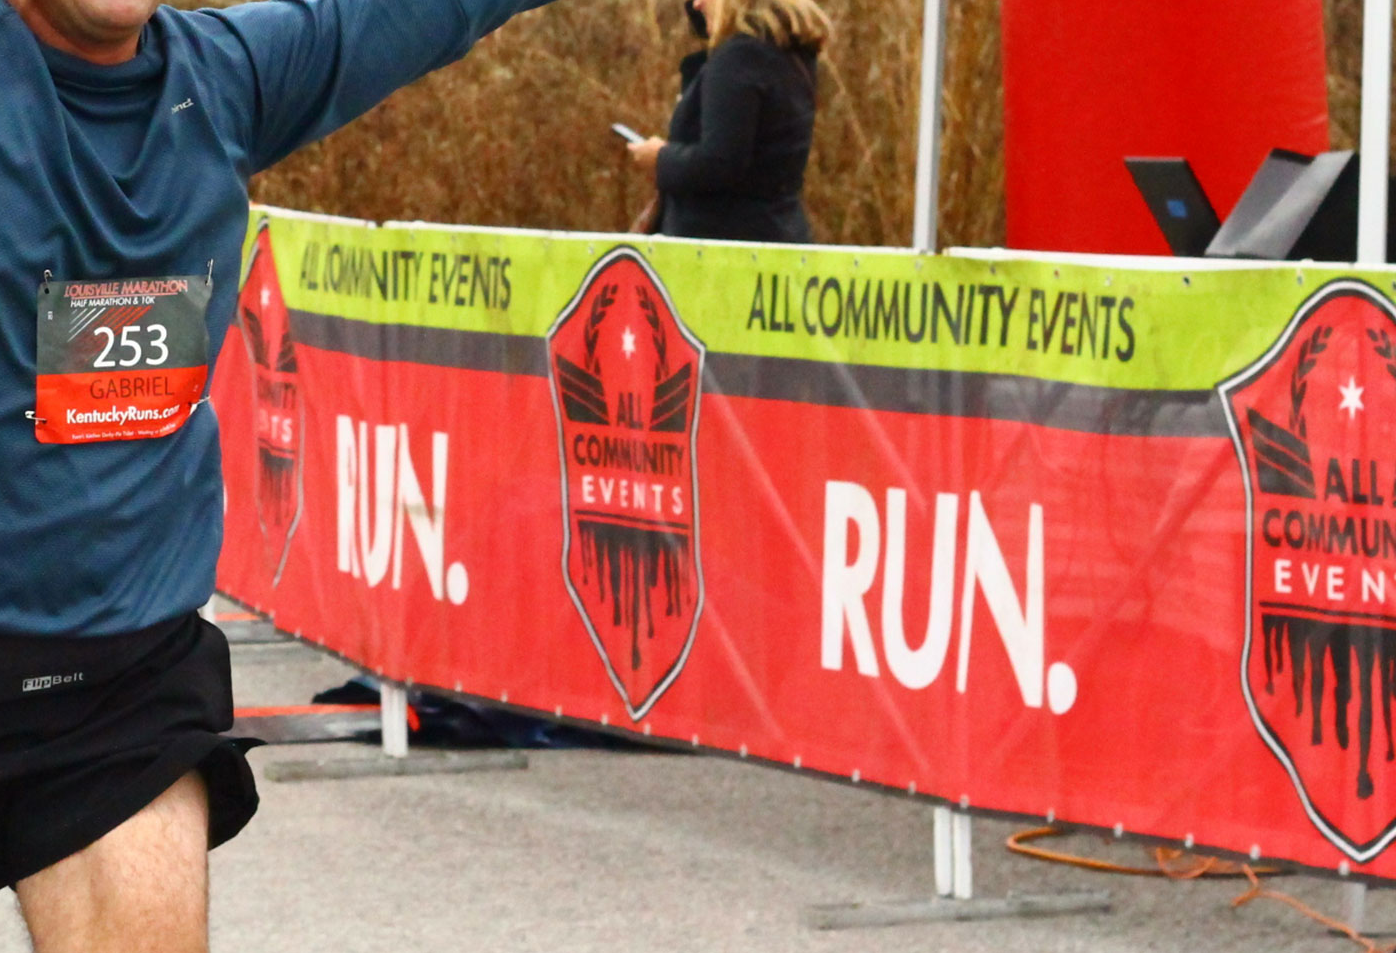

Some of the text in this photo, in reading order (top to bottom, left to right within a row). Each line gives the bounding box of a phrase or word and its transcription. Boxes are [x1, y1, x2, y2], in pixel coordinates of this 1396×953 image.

[63, 279, 189, 298] LOUISVILLE MARATHON
[70, 295, 156, 308] HALF MARATHON & 10K
[429, 252, 512, 311] EVENTS
[747, 273, 1137, 363] ALL COMMUNITY EVENTS
[93, 324, 169, 368] 253
[90, 376, 175, 400] GABRIEL
[616, 392, 644, 431] ALL
[574, 433, 684, 477] COMMUNITY
[582, 475, 684, 516] EVENTS
[1324, 457, 1385, 506] ALL
[336, 414, 469, 606] RUN.
[821, 480, 1078, 715] RUN.
[1274, 558, 1396, 605] EVEN
